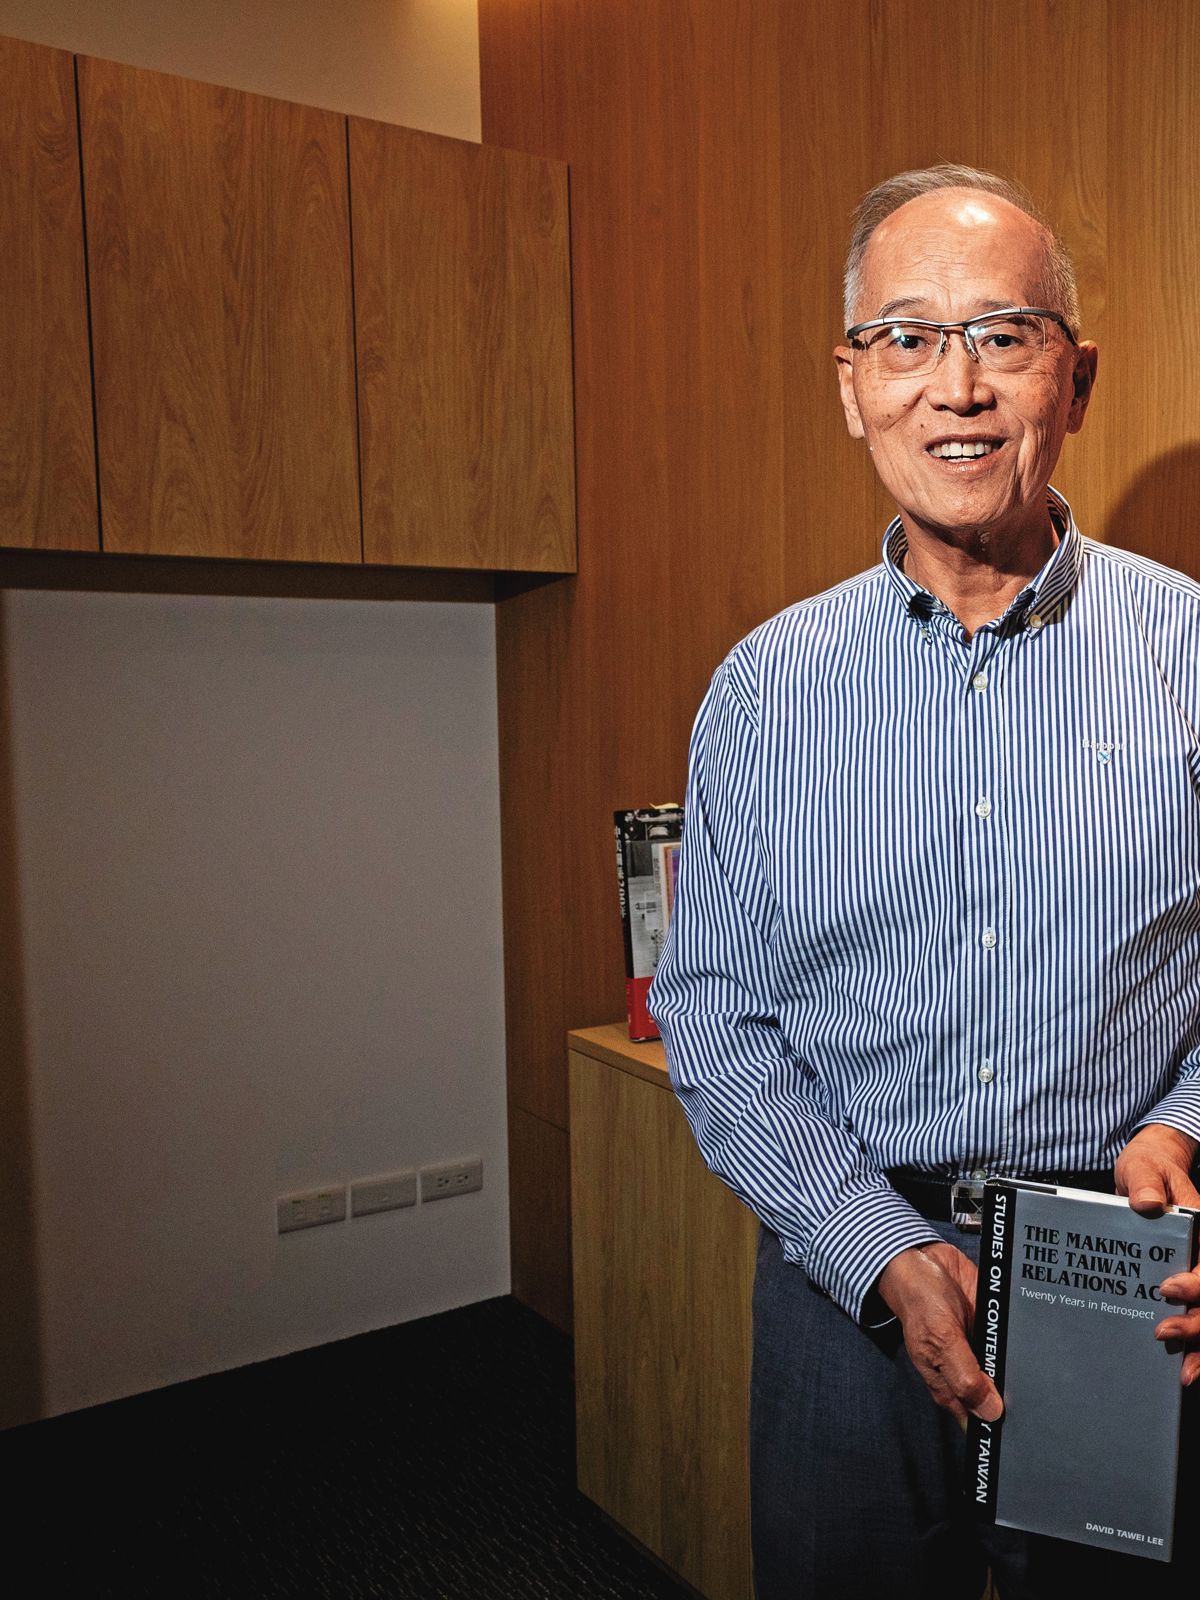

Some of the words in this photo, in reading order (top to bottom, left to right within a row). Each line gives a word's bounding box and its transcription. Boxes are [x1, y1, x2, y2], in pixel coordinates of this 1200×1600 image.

[991, 1194, 1007, 1259] STUDIES
[1024, 1224, 1060, 1245] THE
[1066, 1232, 1141, 1259] MAKING
[1150, 1246, 1176, 1264] OF
[990, 1266, 1002, 1292] ON
[1023, 1244, 1059, 1265] THE
[1065, 1251, 1141, 1279] TAIWAN
[1022, 1263, 1127, 1296] RELATIONS
[1134, 1283, 1169, 1302] AC
[1020, 1287, 1057, 1303] Twenty
[1059, 1295, 1086, 1308] Years
[1088, 1300, 1098, 1310] in
[1100, 1301, 1155, 1320] Retrospect
[981, 1299, 1000, 1432] CONTEMPY
[976, 1438, 991, 1503] TAIWAN
[1085, 1522, 1114, 1535] DAVID
[1116, 1529, 1144, 1542] TAWEI
[1147, 1536, 1164, 1546] LEE
